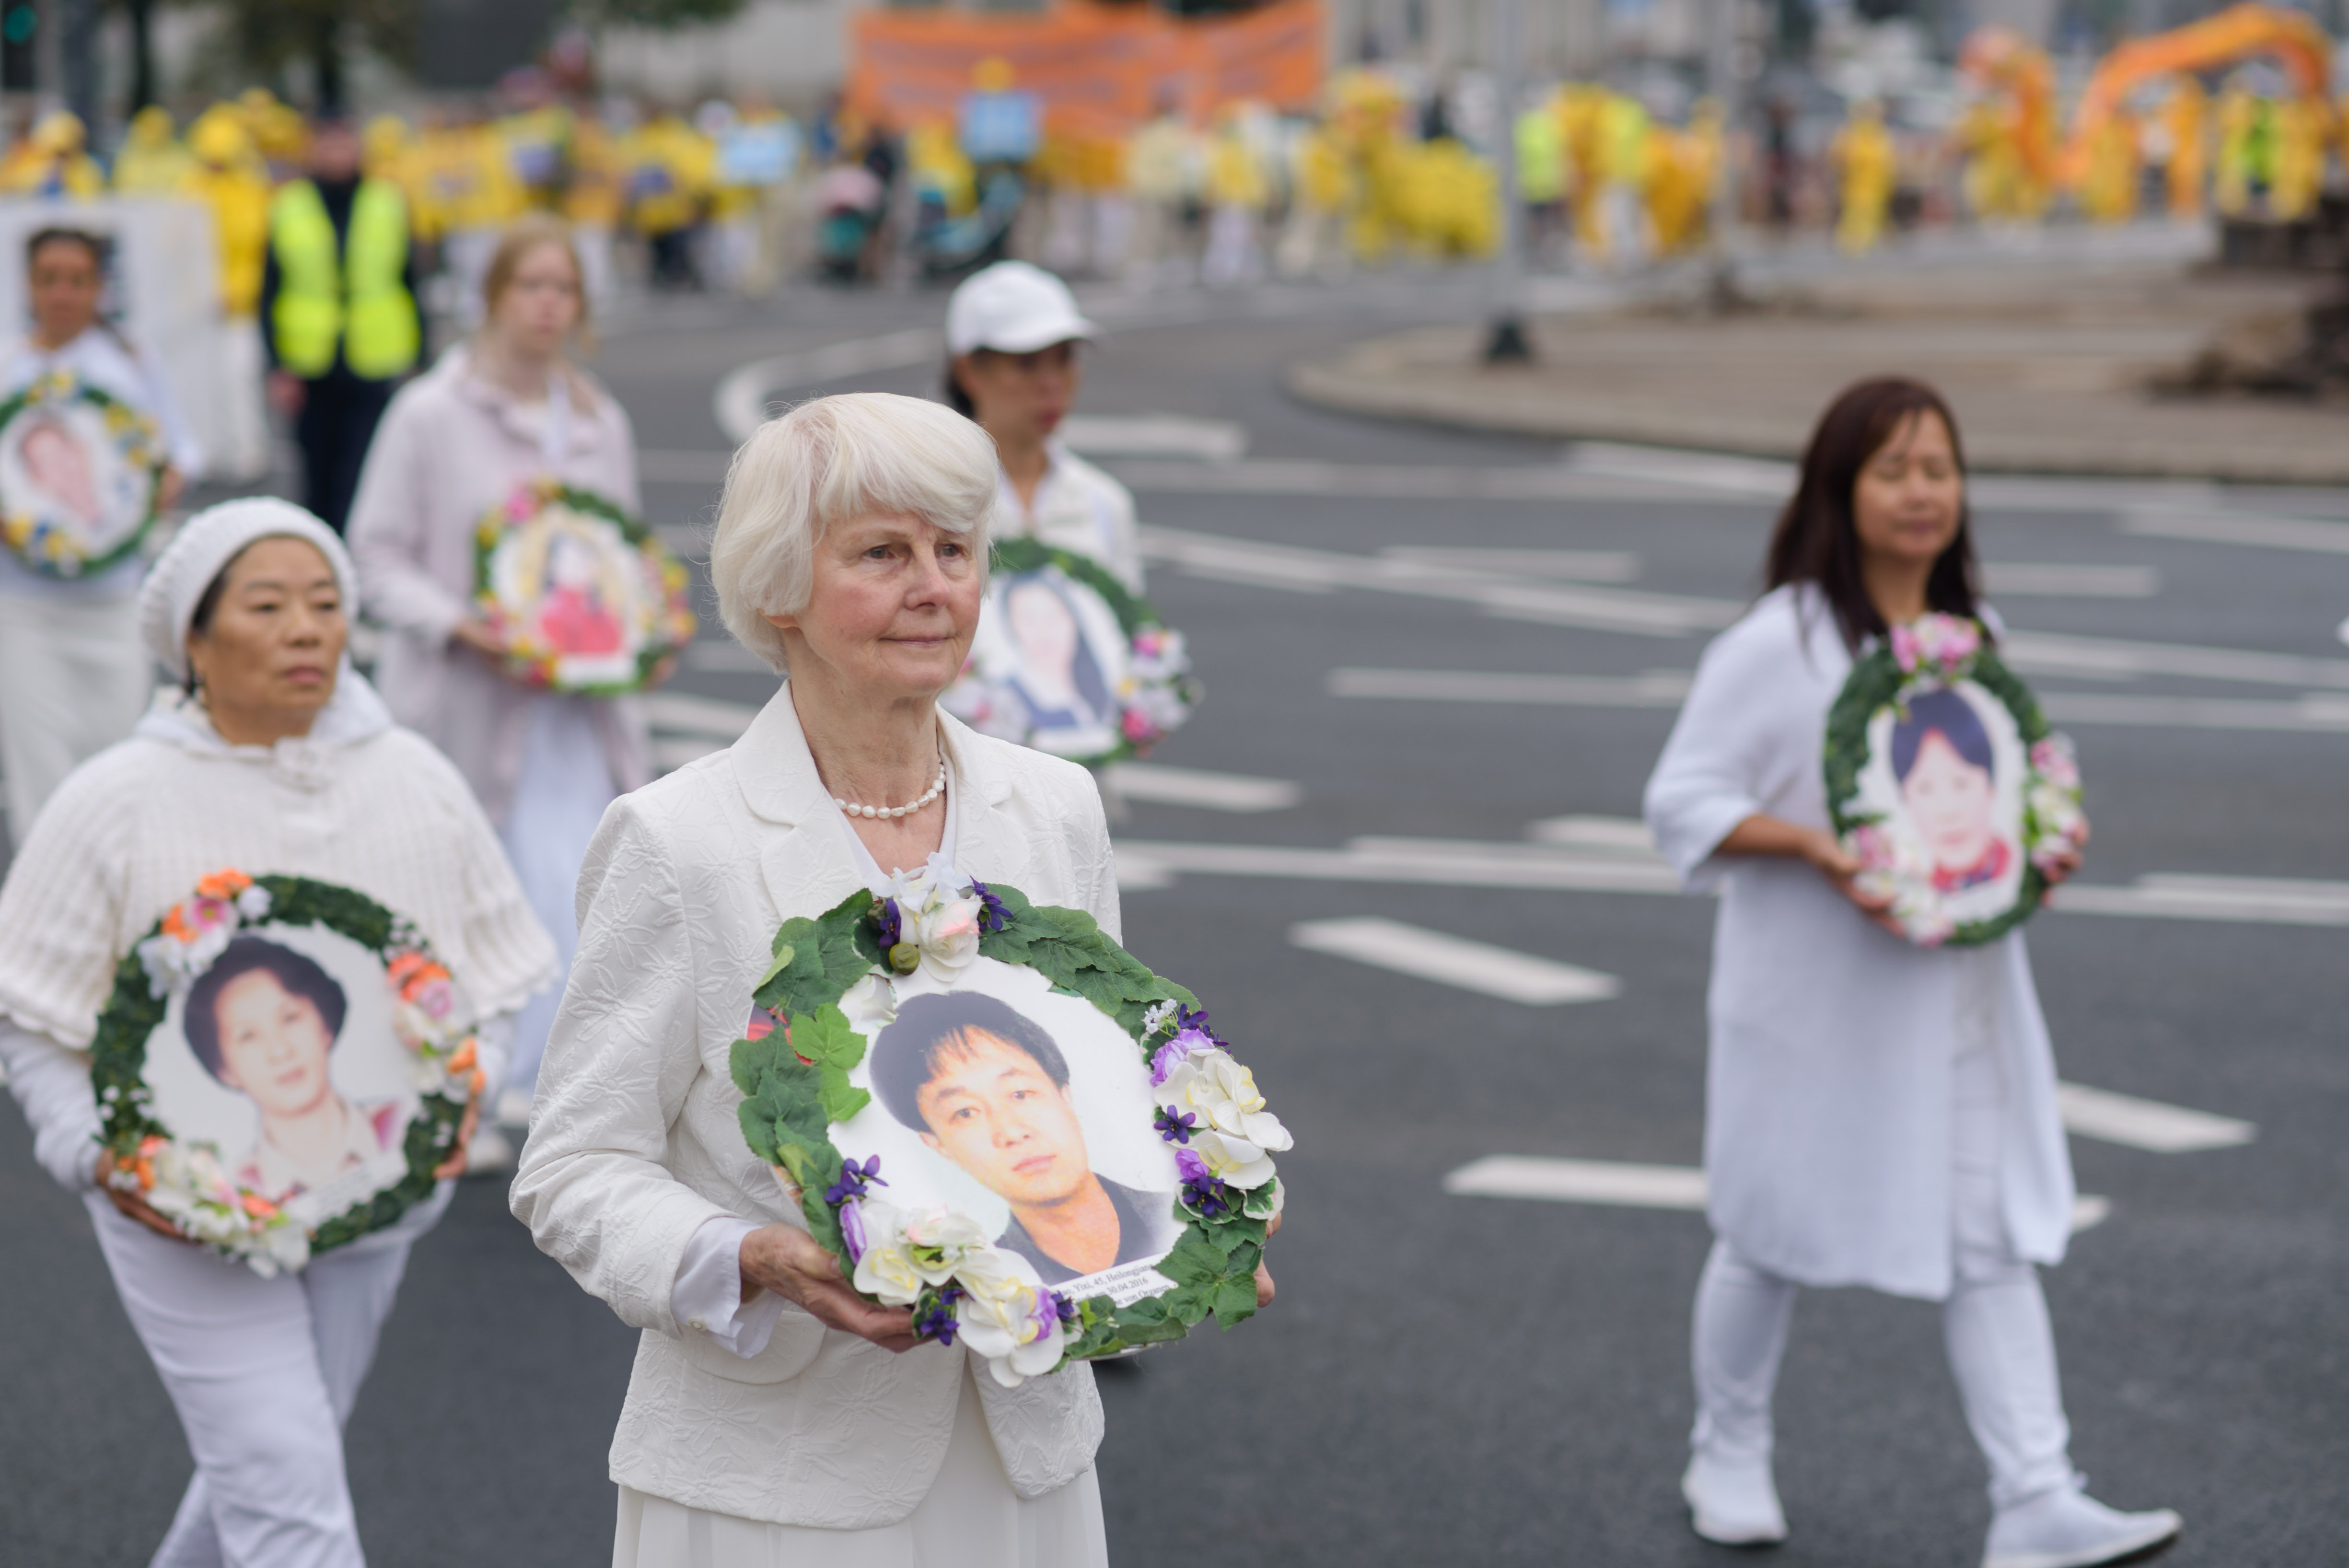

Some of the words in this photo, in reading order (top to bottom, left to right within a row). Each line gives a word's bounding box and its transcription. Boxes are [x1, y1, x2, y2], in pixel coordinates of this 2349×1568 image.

[1094, 1276, 1107, 1286] 45,
[1106, 1277, 1149, 1295] 30.04.2016
[1123, 1294, 1138, 1302] von
[1138, 1284, 1170, 1298] Organen
